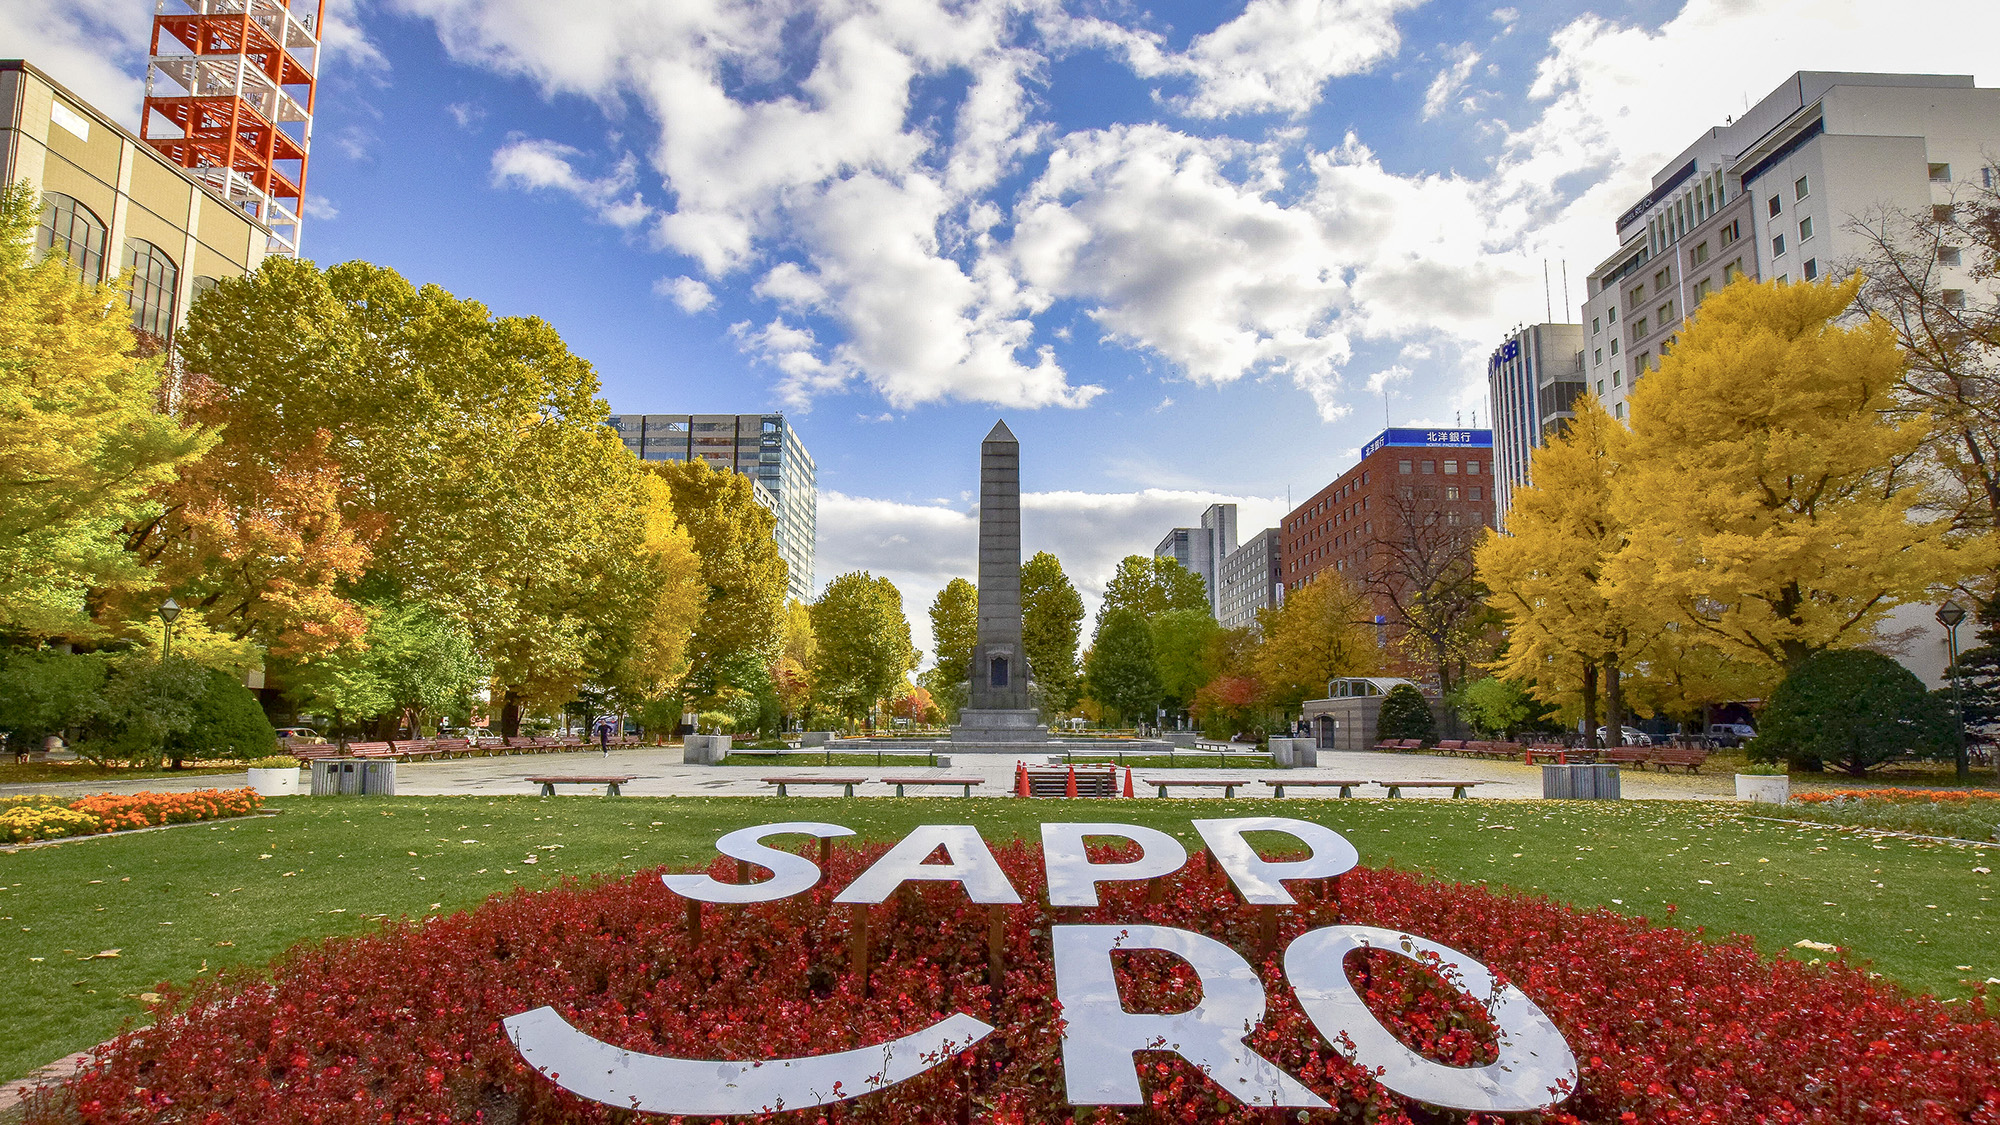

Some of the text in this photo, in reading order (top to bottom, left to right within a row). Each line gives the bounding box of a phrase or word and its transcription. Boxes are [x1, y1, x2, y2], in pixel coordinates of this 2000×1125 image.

[1365, 435, 1385, 457] 北洋銀行
[1426, 431, 1471, 442] 北洋銀行
[662, 816, 1360, 905] SAPP
[1051, 924, 1578, 1112] RO
